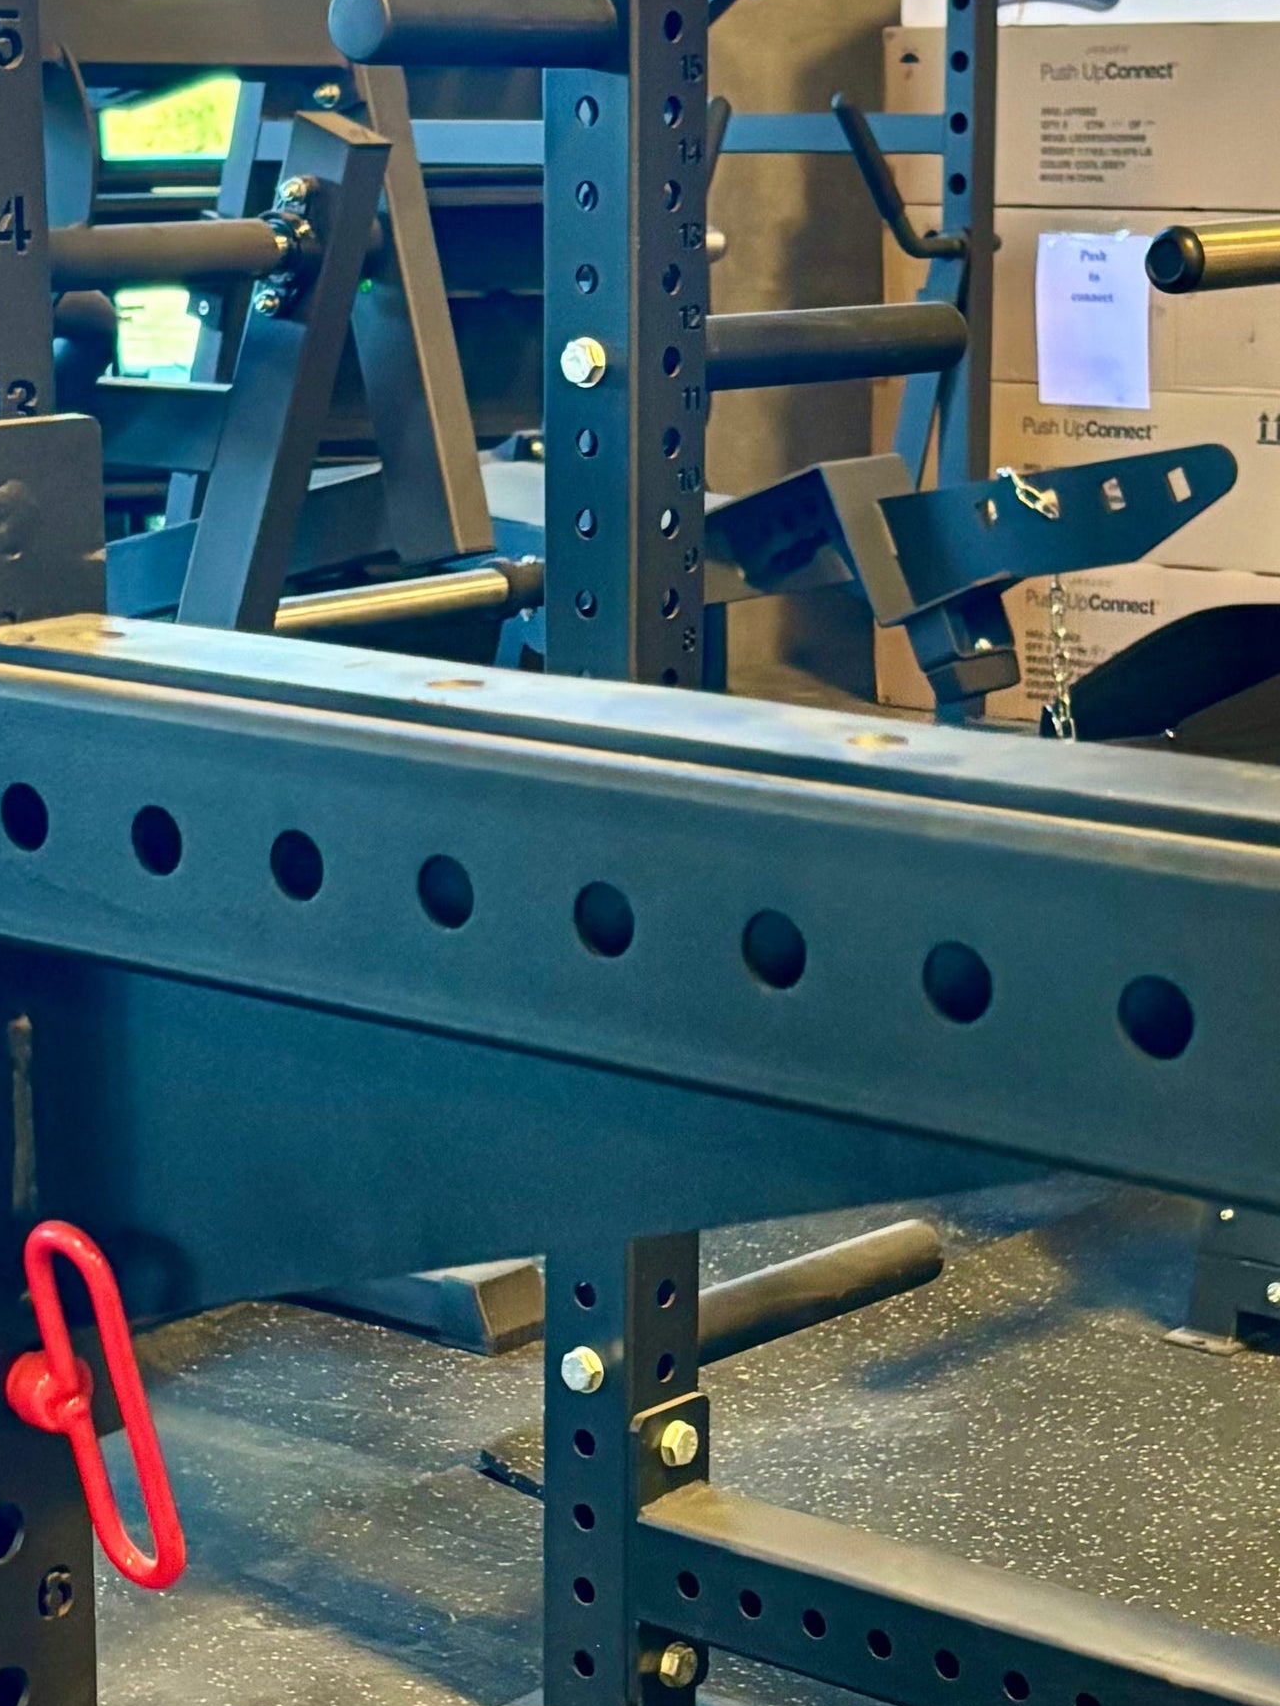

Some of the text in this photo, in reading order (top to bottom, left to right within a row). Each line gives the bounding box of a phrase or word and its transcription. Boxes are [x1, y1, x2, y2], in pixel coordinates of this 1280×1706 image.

[679, 54, 704, 82] 15
[1040, 63, 1078, 82] Push
[677, 138, 704, 165] 14
[678, 222, 703, 251] 13
[1080, 250, 1107, 262] Push
[678, 304, 703, 331] 12
[1023, 417, 1059, 436] Push
[38, 1564, 74, 1621] 6
